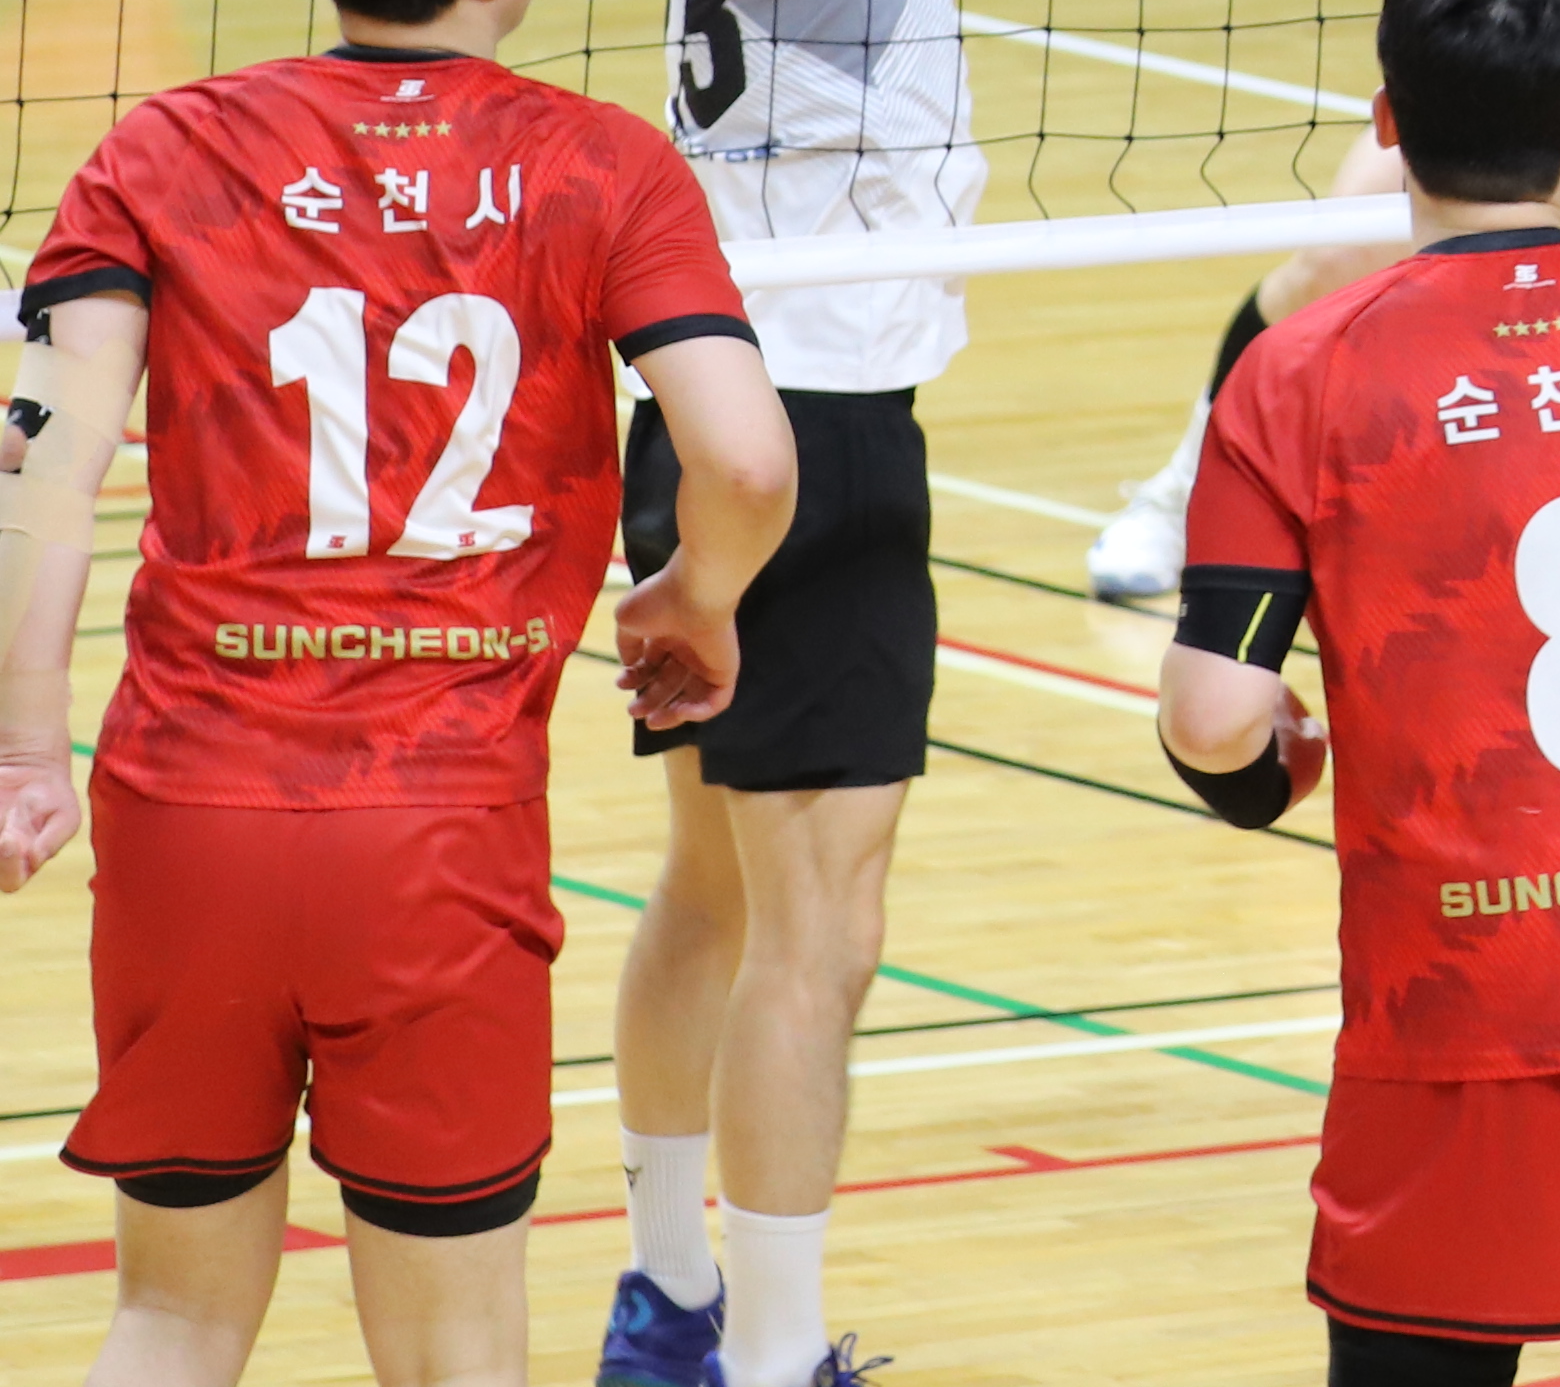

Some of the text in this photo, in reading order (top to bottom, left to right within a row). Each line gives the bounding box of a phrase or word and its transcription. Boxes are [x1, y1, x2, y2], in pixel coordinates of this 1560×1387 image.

[280, 162, 524, 236] 순천시
[268, 286, 535, 562] 12
[215, 615, 562, 661] SUNCHEON-S
